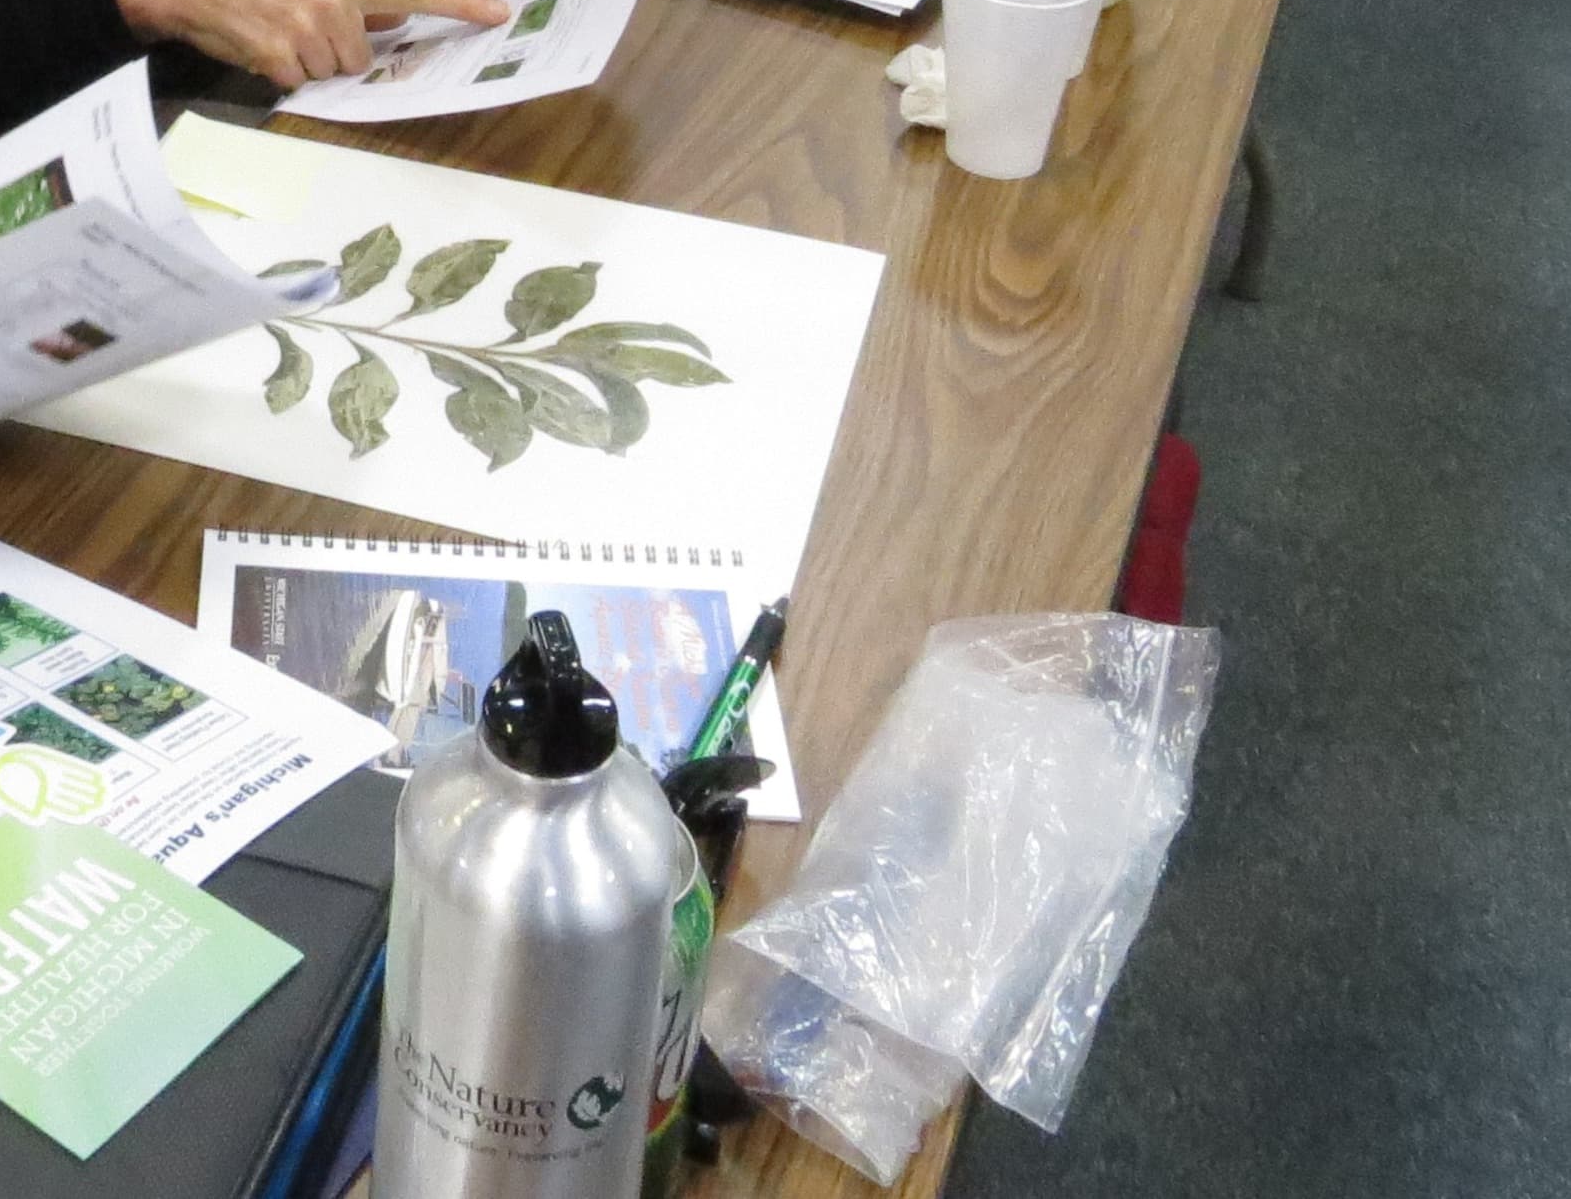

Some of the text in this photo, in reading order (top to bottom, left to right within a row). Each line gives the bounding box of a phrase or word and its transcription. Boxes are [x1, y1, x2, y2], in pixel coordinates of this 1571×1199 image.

[205, 752, 314, 823] Michigan's
[103, 889, 164, 936] FOR
[9, 907, 191, 1064] IN MICHIGAN
[34, 926, 213, 1079] WORKING TOGETHER
[393, 1045, 556, 1148] Conservancy
[429, 1051, 557, 1120] Nature
